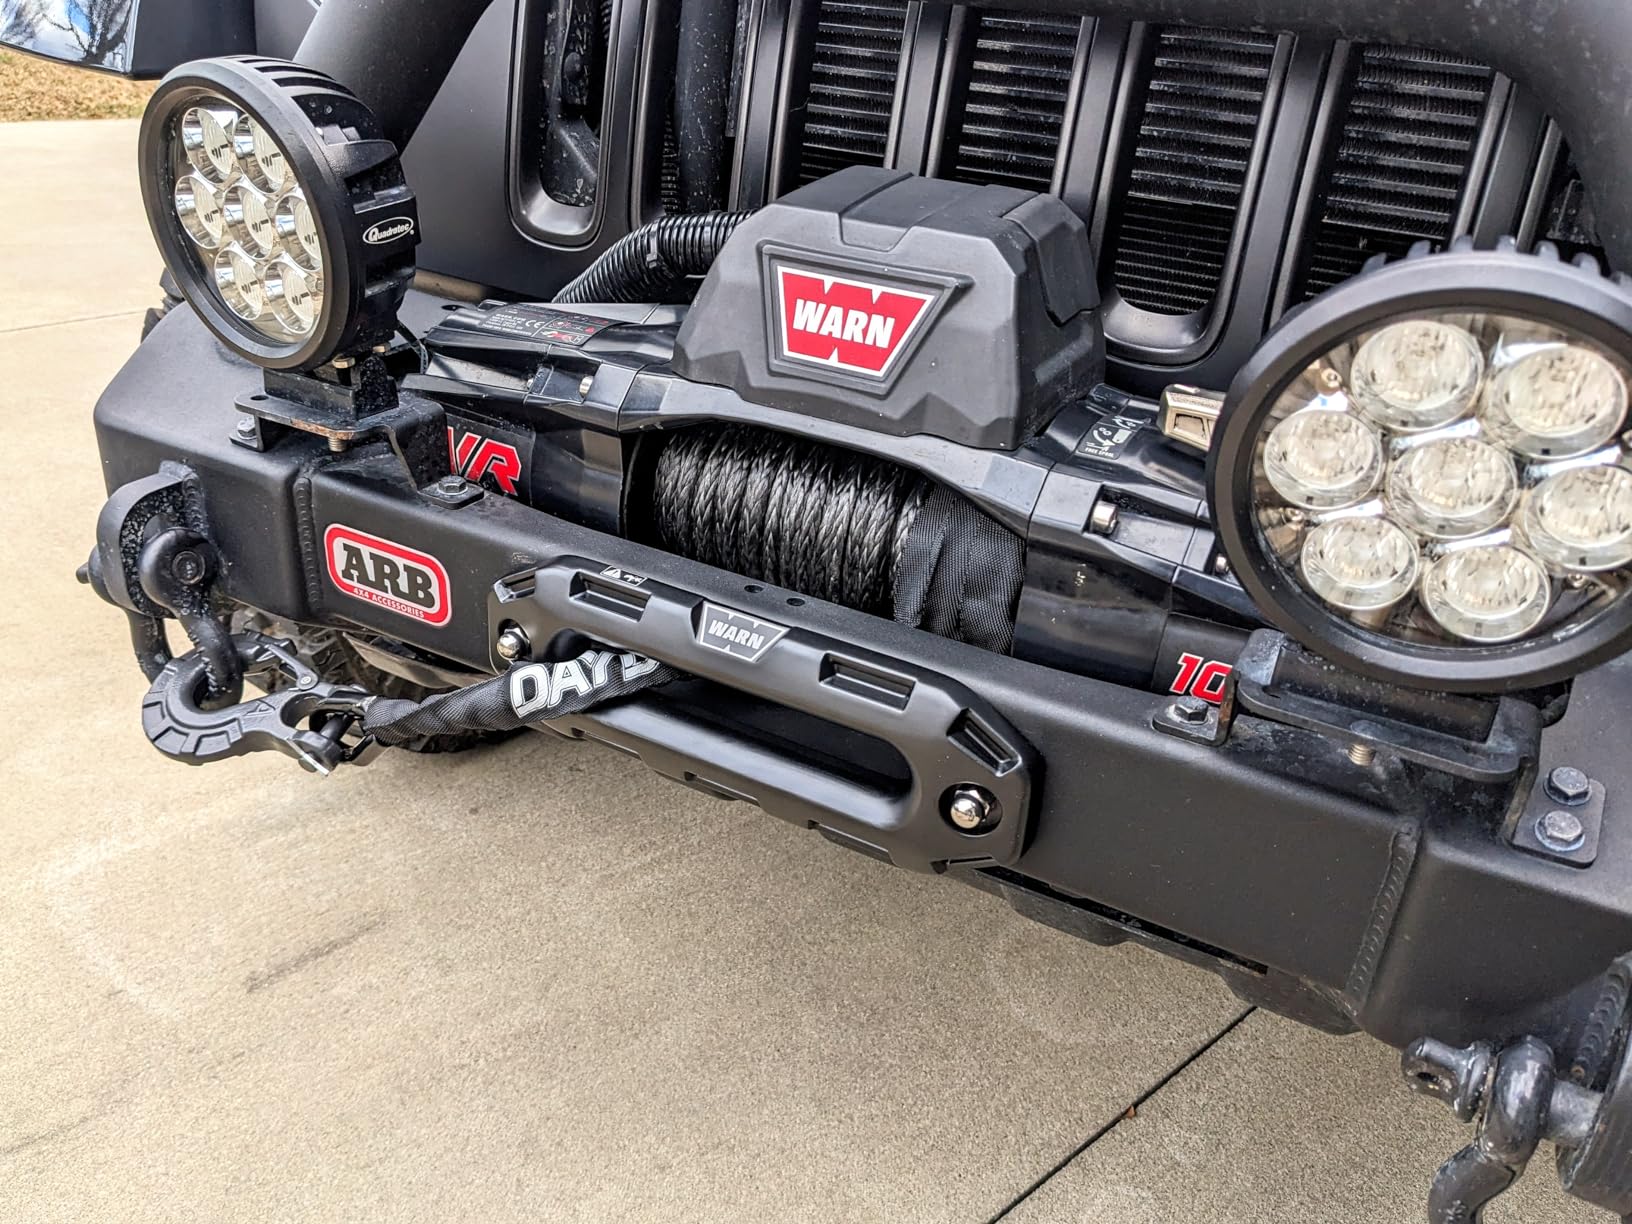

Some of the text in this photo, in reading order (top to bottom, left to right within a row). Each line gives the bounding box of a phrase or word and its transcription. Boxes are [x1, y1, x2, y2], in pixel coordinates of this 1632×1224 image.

[792, 298, 896, 349] WARN
[341, 542, 435, 609] ARB
[371, 594, 425, 618] ACCESSORIES
[707, 619, 765, 650] WARN
